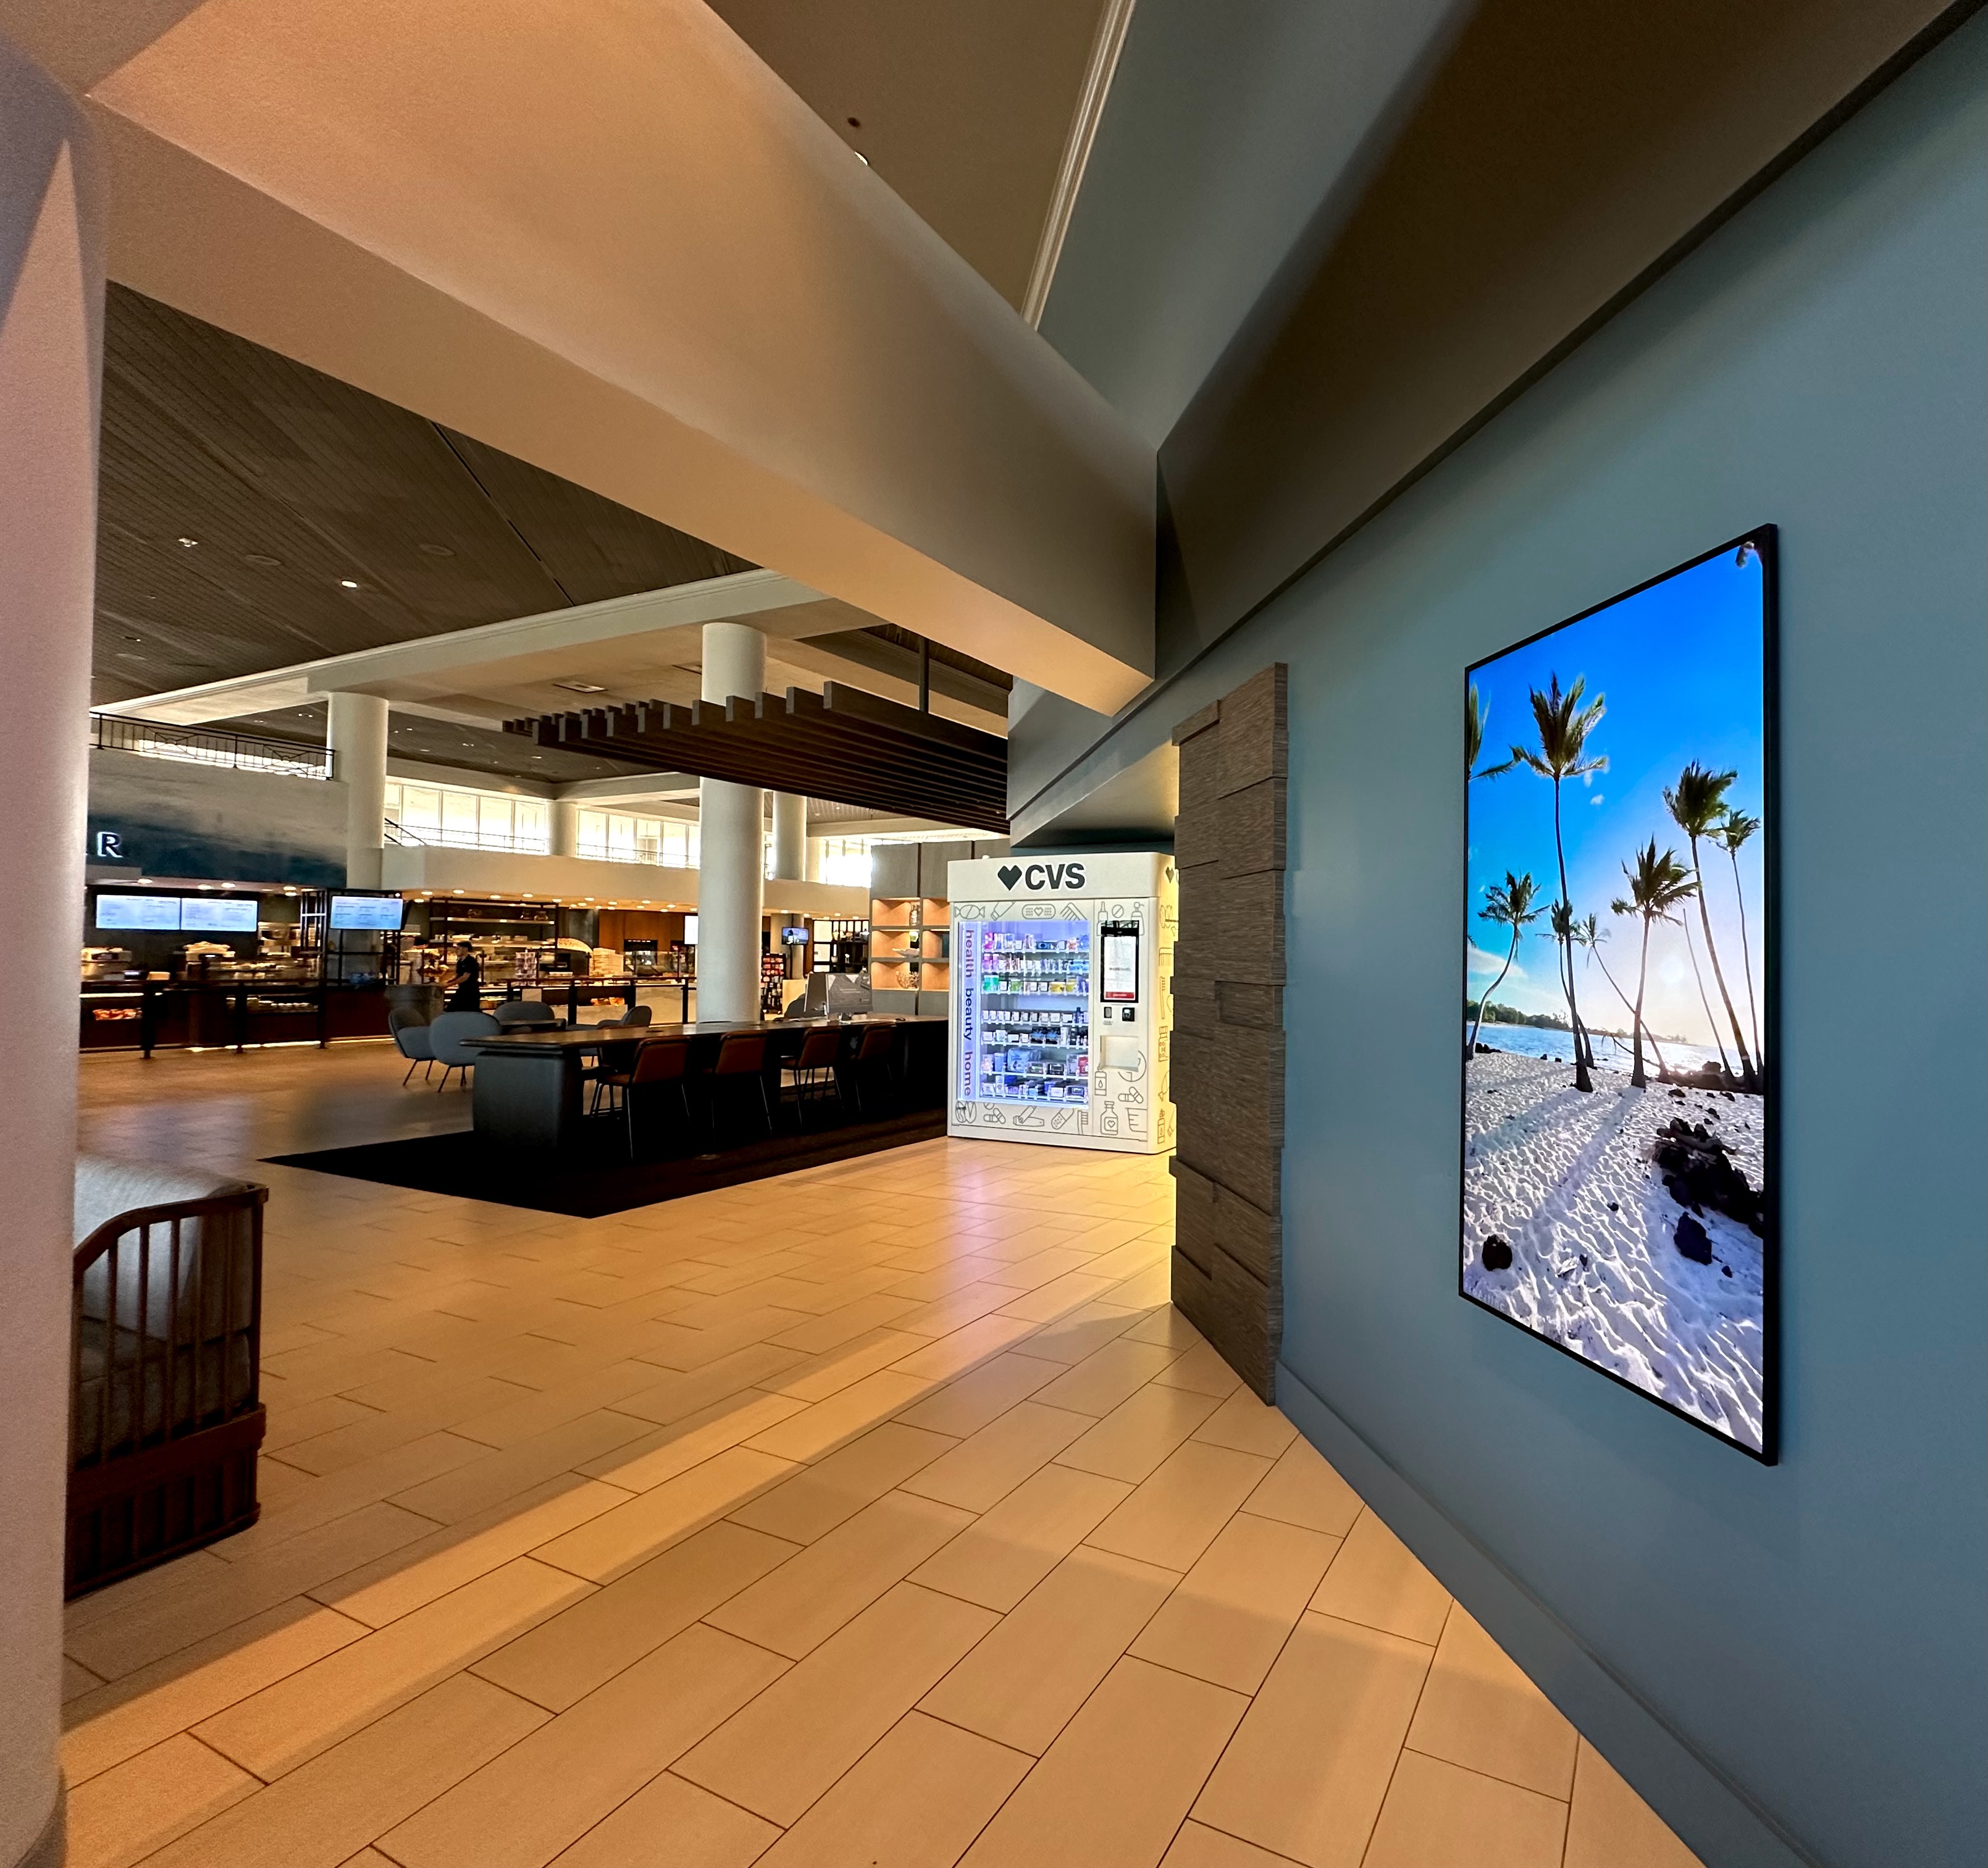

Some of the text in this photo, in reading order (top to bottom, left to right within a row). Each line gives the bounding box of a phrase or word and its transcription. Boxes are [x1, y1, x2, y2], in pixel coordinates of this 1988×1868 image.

[96, 831, 124, 857] R
[1025, 863, 1085, 890] CVS
[964, 930, 975, 1096] health beauty home
